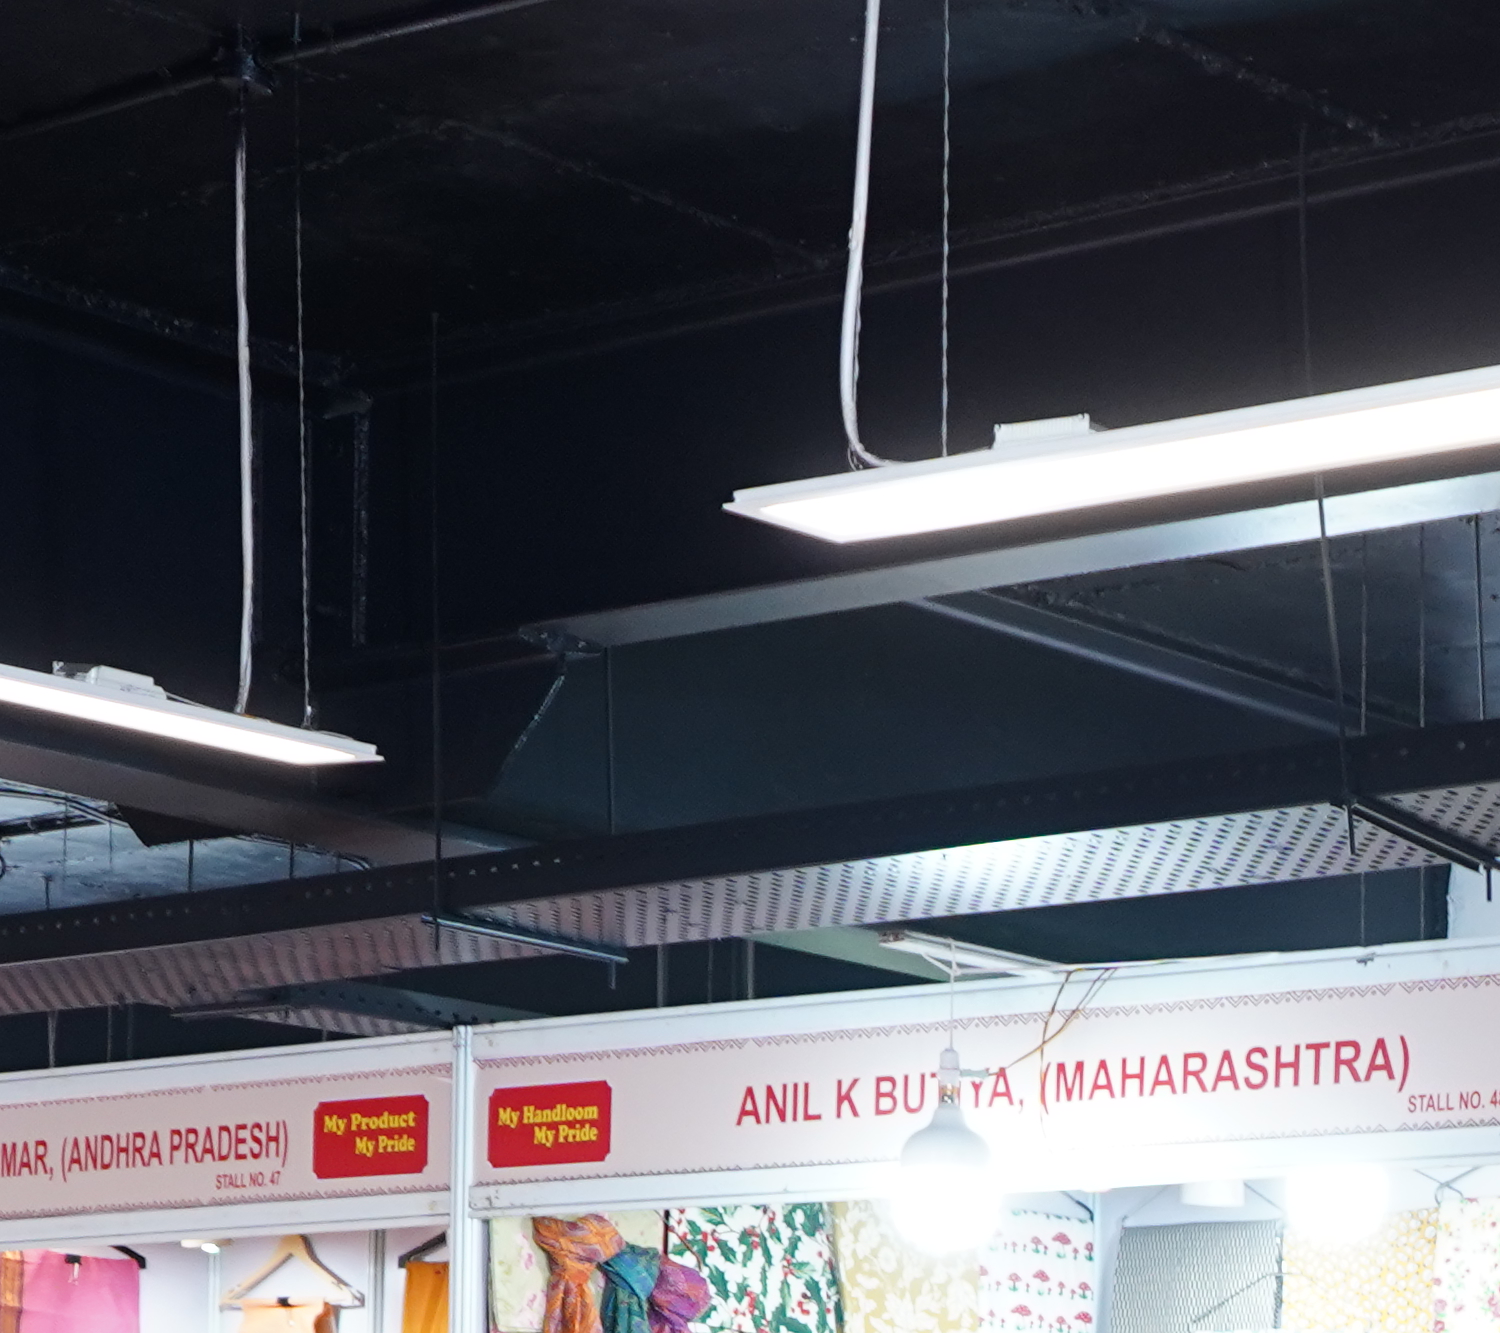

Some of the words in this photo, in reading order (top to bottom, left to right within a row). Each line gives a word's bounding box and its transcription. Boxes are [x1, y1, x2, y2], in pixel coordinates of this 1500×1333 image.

[736, 1080, 822, 1127] ANIL
[836, 1078, 861, 1120] K
[1040, 1034, 1411, 1115] (MAHARASHTRA)
[1407, 1093, 1455, 1114] STALL
[1459, 1091, 1486, 1111] NO.
[324, 1114, 347, 1135] My
[350, 1110, 416, 1130] Product
[498, 1107, 520, 1129] My
[522, 1102, 598, 1124] Handloom
[355, 1136, 377, 1157] My
[378, 1134, 416, 1153] Pride
[534, 1124, 557, 1147] My
[558, 1122, 598, 1143] Pride
[61, 1130, 164, 1183] (ANDHRA
[169, 1119, 289, 1168] PRADESH)
[215, 1172, 247, 1190] STALL
[249, 1171, 266, 1188] NO.
[269, 1171, 281, 1186] 47
